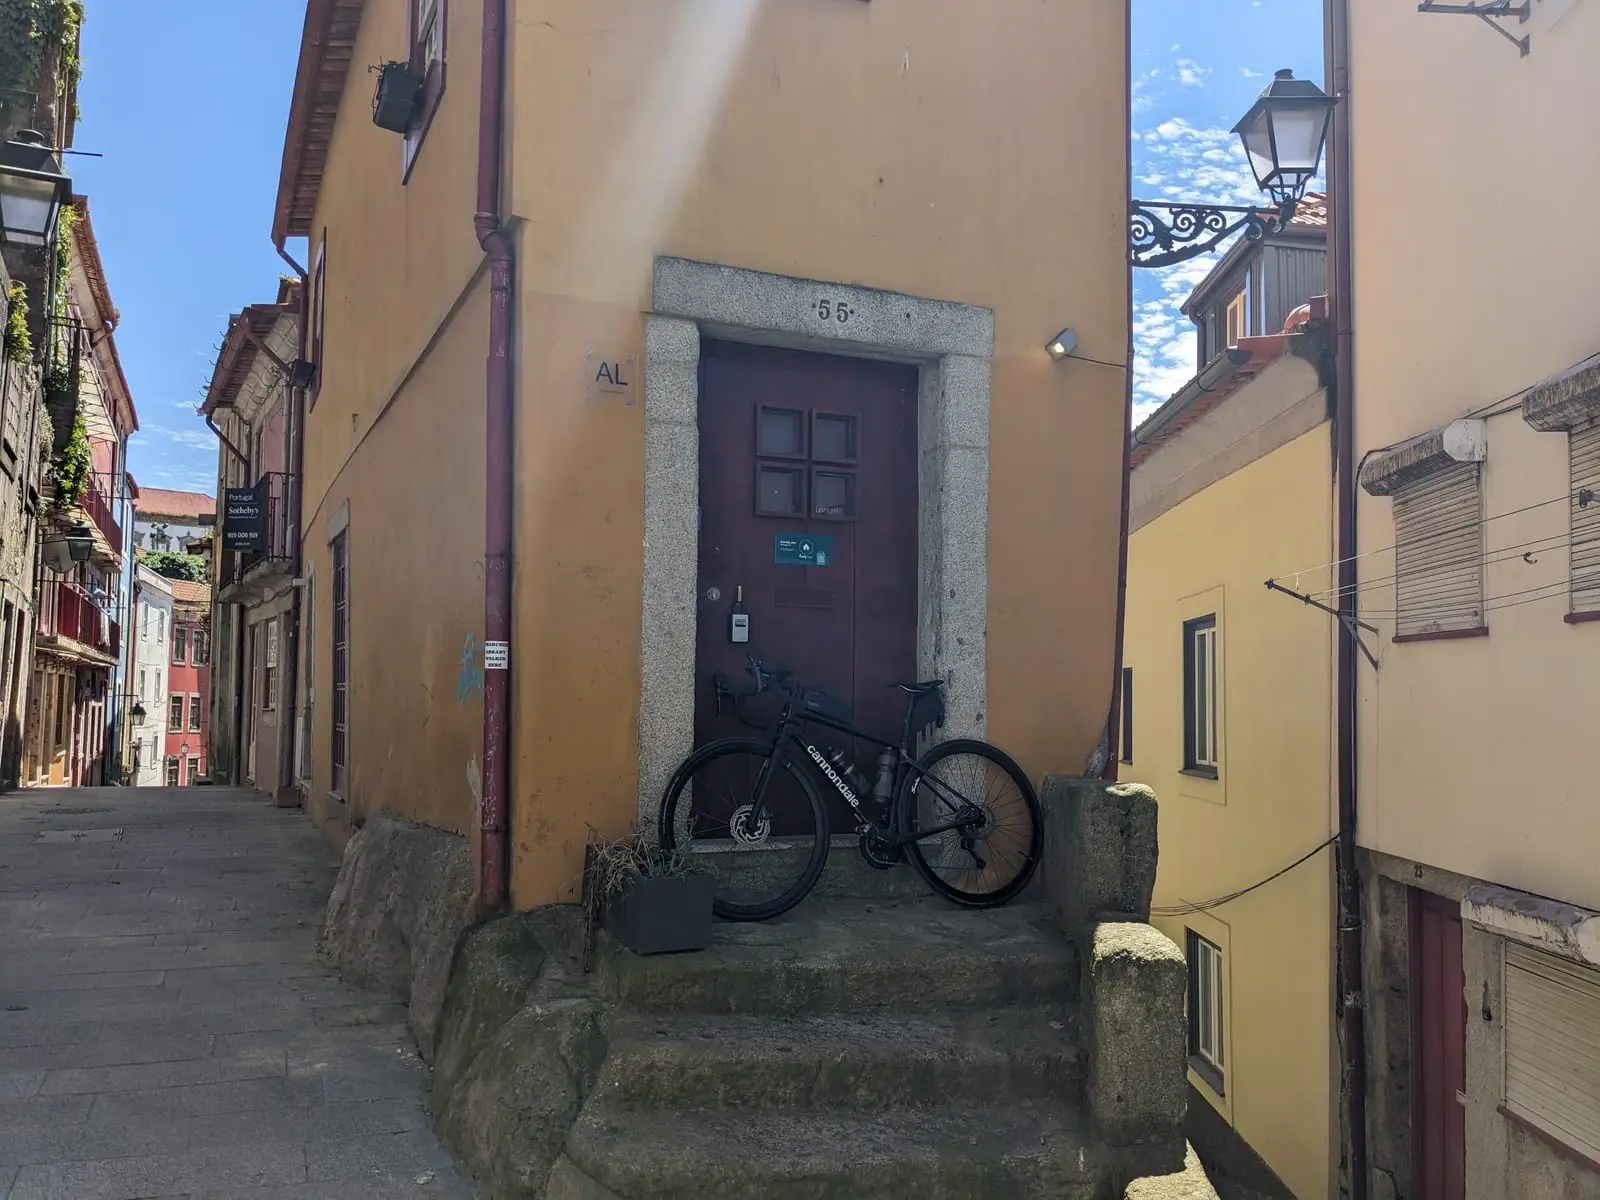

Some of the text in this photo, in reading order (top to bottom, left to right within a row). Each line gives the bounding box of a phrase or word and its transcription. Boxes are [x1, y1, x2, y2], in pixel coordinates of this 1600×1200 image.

[818, 299, 849, 323] 55
[595, 361, 628, 386] AL
[228, 493, 253, 501] Portugal
[228, 506, 259, 516] Sotheby's
[807, 745, 860, 808] cannondale
